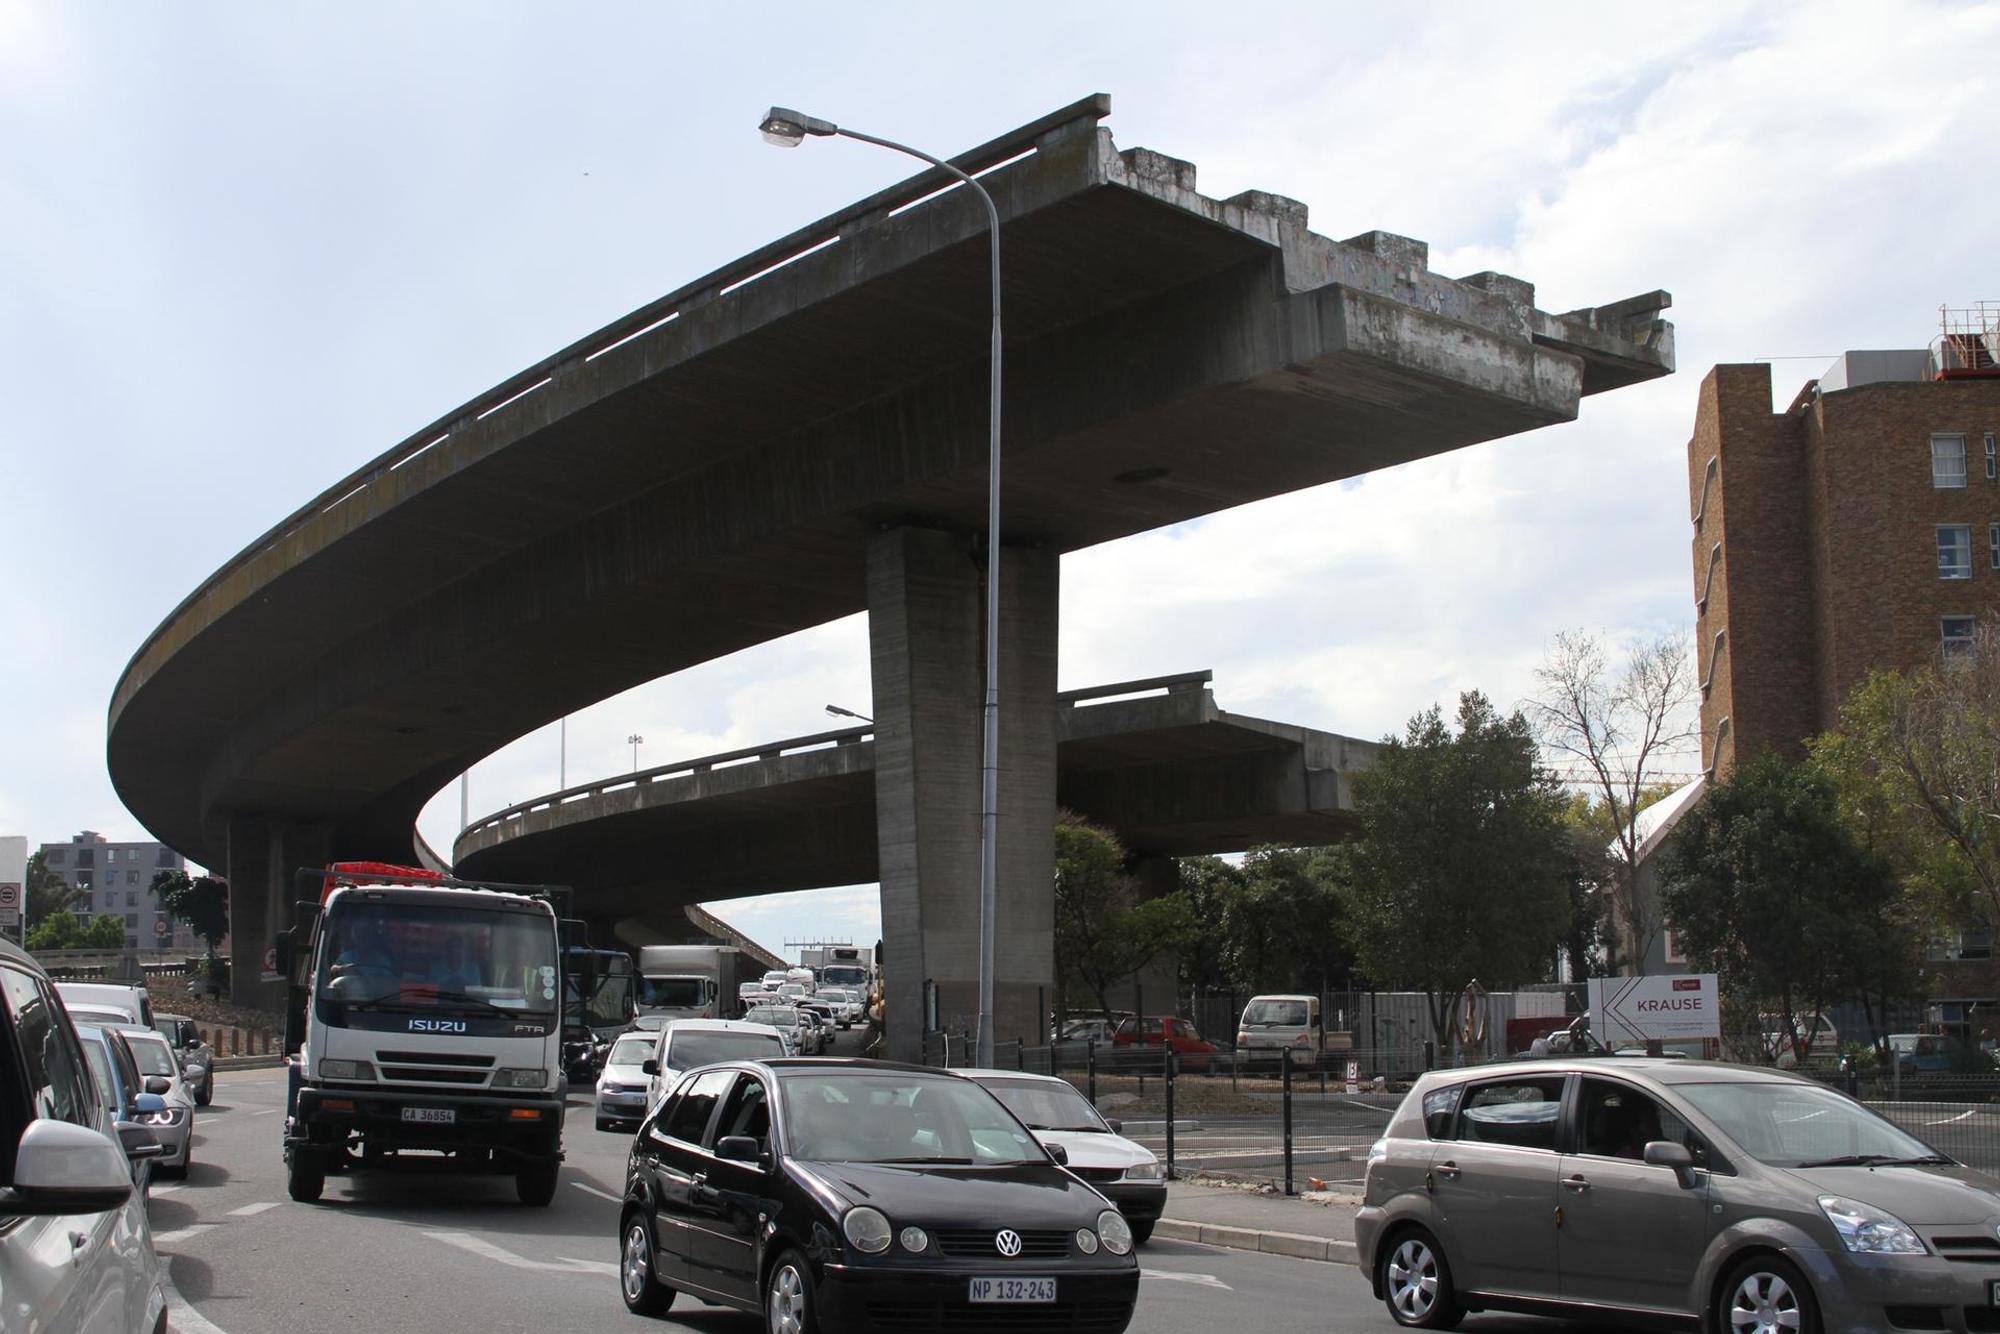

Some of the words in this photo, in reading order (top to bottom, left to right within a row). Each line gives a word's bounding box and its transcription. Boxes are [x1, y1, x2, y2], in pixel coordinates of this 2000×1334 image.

[1637, 998, 1703, 1012] KRAUSE
[408, 1019, 466, 1032] ISUZU
[403, 1109, 416, 1120] CA
[972, 1280, 991, 1299] NP
